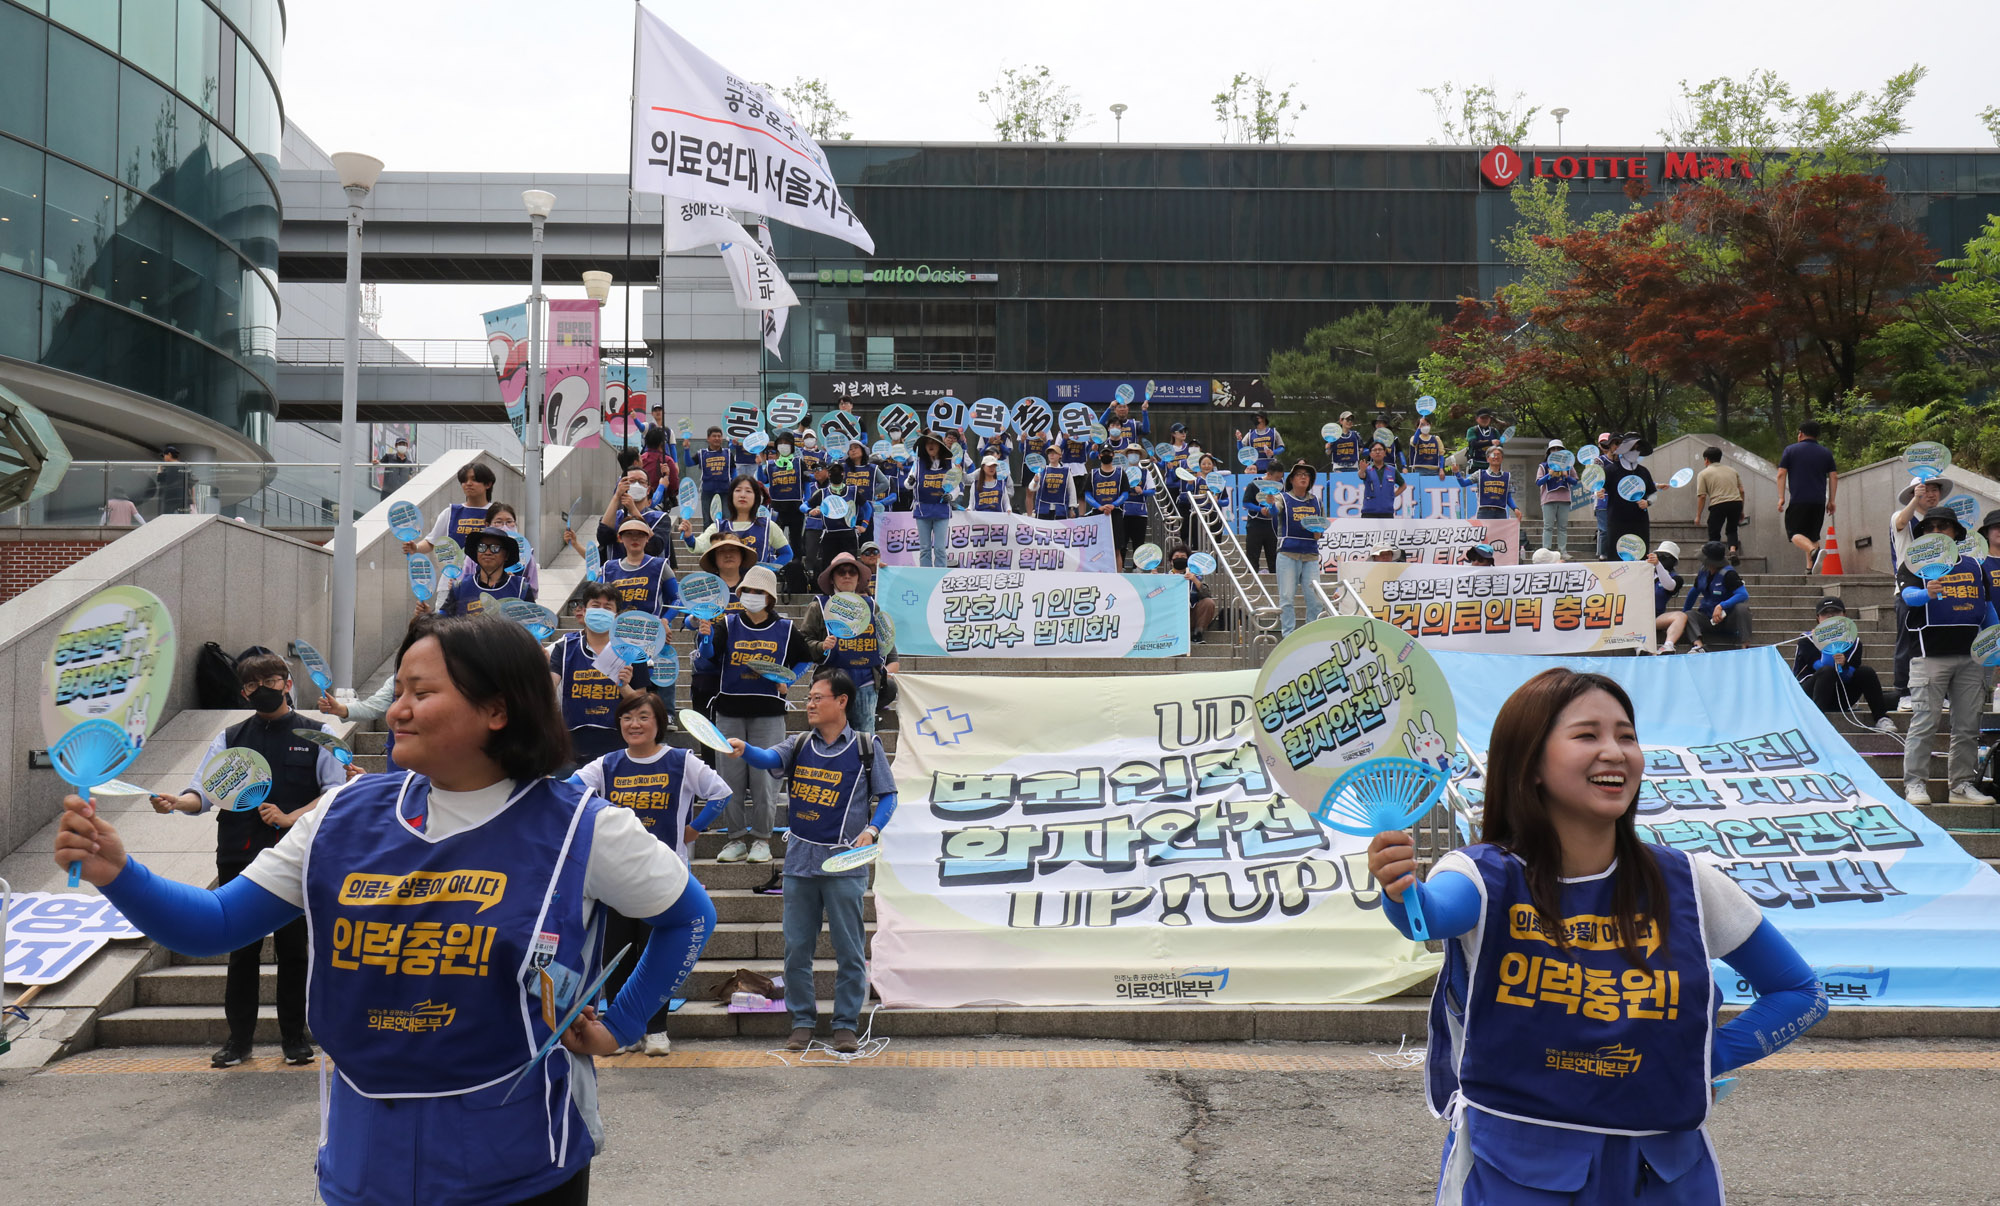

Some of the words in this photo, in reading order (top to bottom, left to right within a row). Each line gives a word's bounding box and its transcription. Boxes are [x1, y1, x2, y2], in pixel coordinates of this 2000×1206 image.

[648, 130, 758, 194] 의료연대
[1533, 156, 1649, 179] LOTTE
[872, 265, 966, 283] autoOasis
[727, 406, 758, 438] 공
[770, 398, 804, 424] 공
[932, 402, 964, 432] 인
[973, 403, 1004, 434] 력
[1062, 407, 1092, 436] 원
[1015, 523, 1098, 549] 정규직화!
[1400, 528, 1454, 546] 노동개악
[1452, 526, 1488, 543] 저지!
[1019, 547, 1065, 570] 확대!
[942, 574, 993, 594] 간호인력
[994, 572, 1025, 590] 충원!
[1382, 578, 1453, 601] 병원인력
[1457, 574, 1509, 598] 직종별
[1513, 570, 1587, 595] 기준마련
[943, 591, 1023, 624] 간호사
[1032, 585, 1100, 618] 1인당
[1553, 594, 1627, 632] 충원!
[946, 621, 1024, 652] 환자수
[1033, 615, 1120, 647] 법제화!
[571, 682, 620, 700] 인력충원!
[1255, 656, 1350, 734] 병원인력
[1281, 688, 1387, 771] 환자안전
[1688, 729, 1819, 775] 퇴진!
[929, 742, 1274, 822] 병원인력
[1723, 772, 1860, 805] 저지!
[610, 790, 670, 809] 인력충원!
[936, 792, 1330, 887] 환자안전
[1634, 805, 1925, 859] 력인권법
[345, 879, 395, 899] 의료는
[396, 876, 447, 898] 상품이
[447, 874, 500, 897] 아니다
[1715, 858, 1908, 910] 하라!
[332, 917, 497, 976] 인력충원!
[1114, 974, 1139, 982] 민주노총
[1116, 980, 1215, 999] 의료연대본부
[1496, 952, 1680, 1022] 인력충원!
[367, 1015, 442, 1032] 의료연대본부
[1545, 1056, 1629, 1078] 의료연대본부
